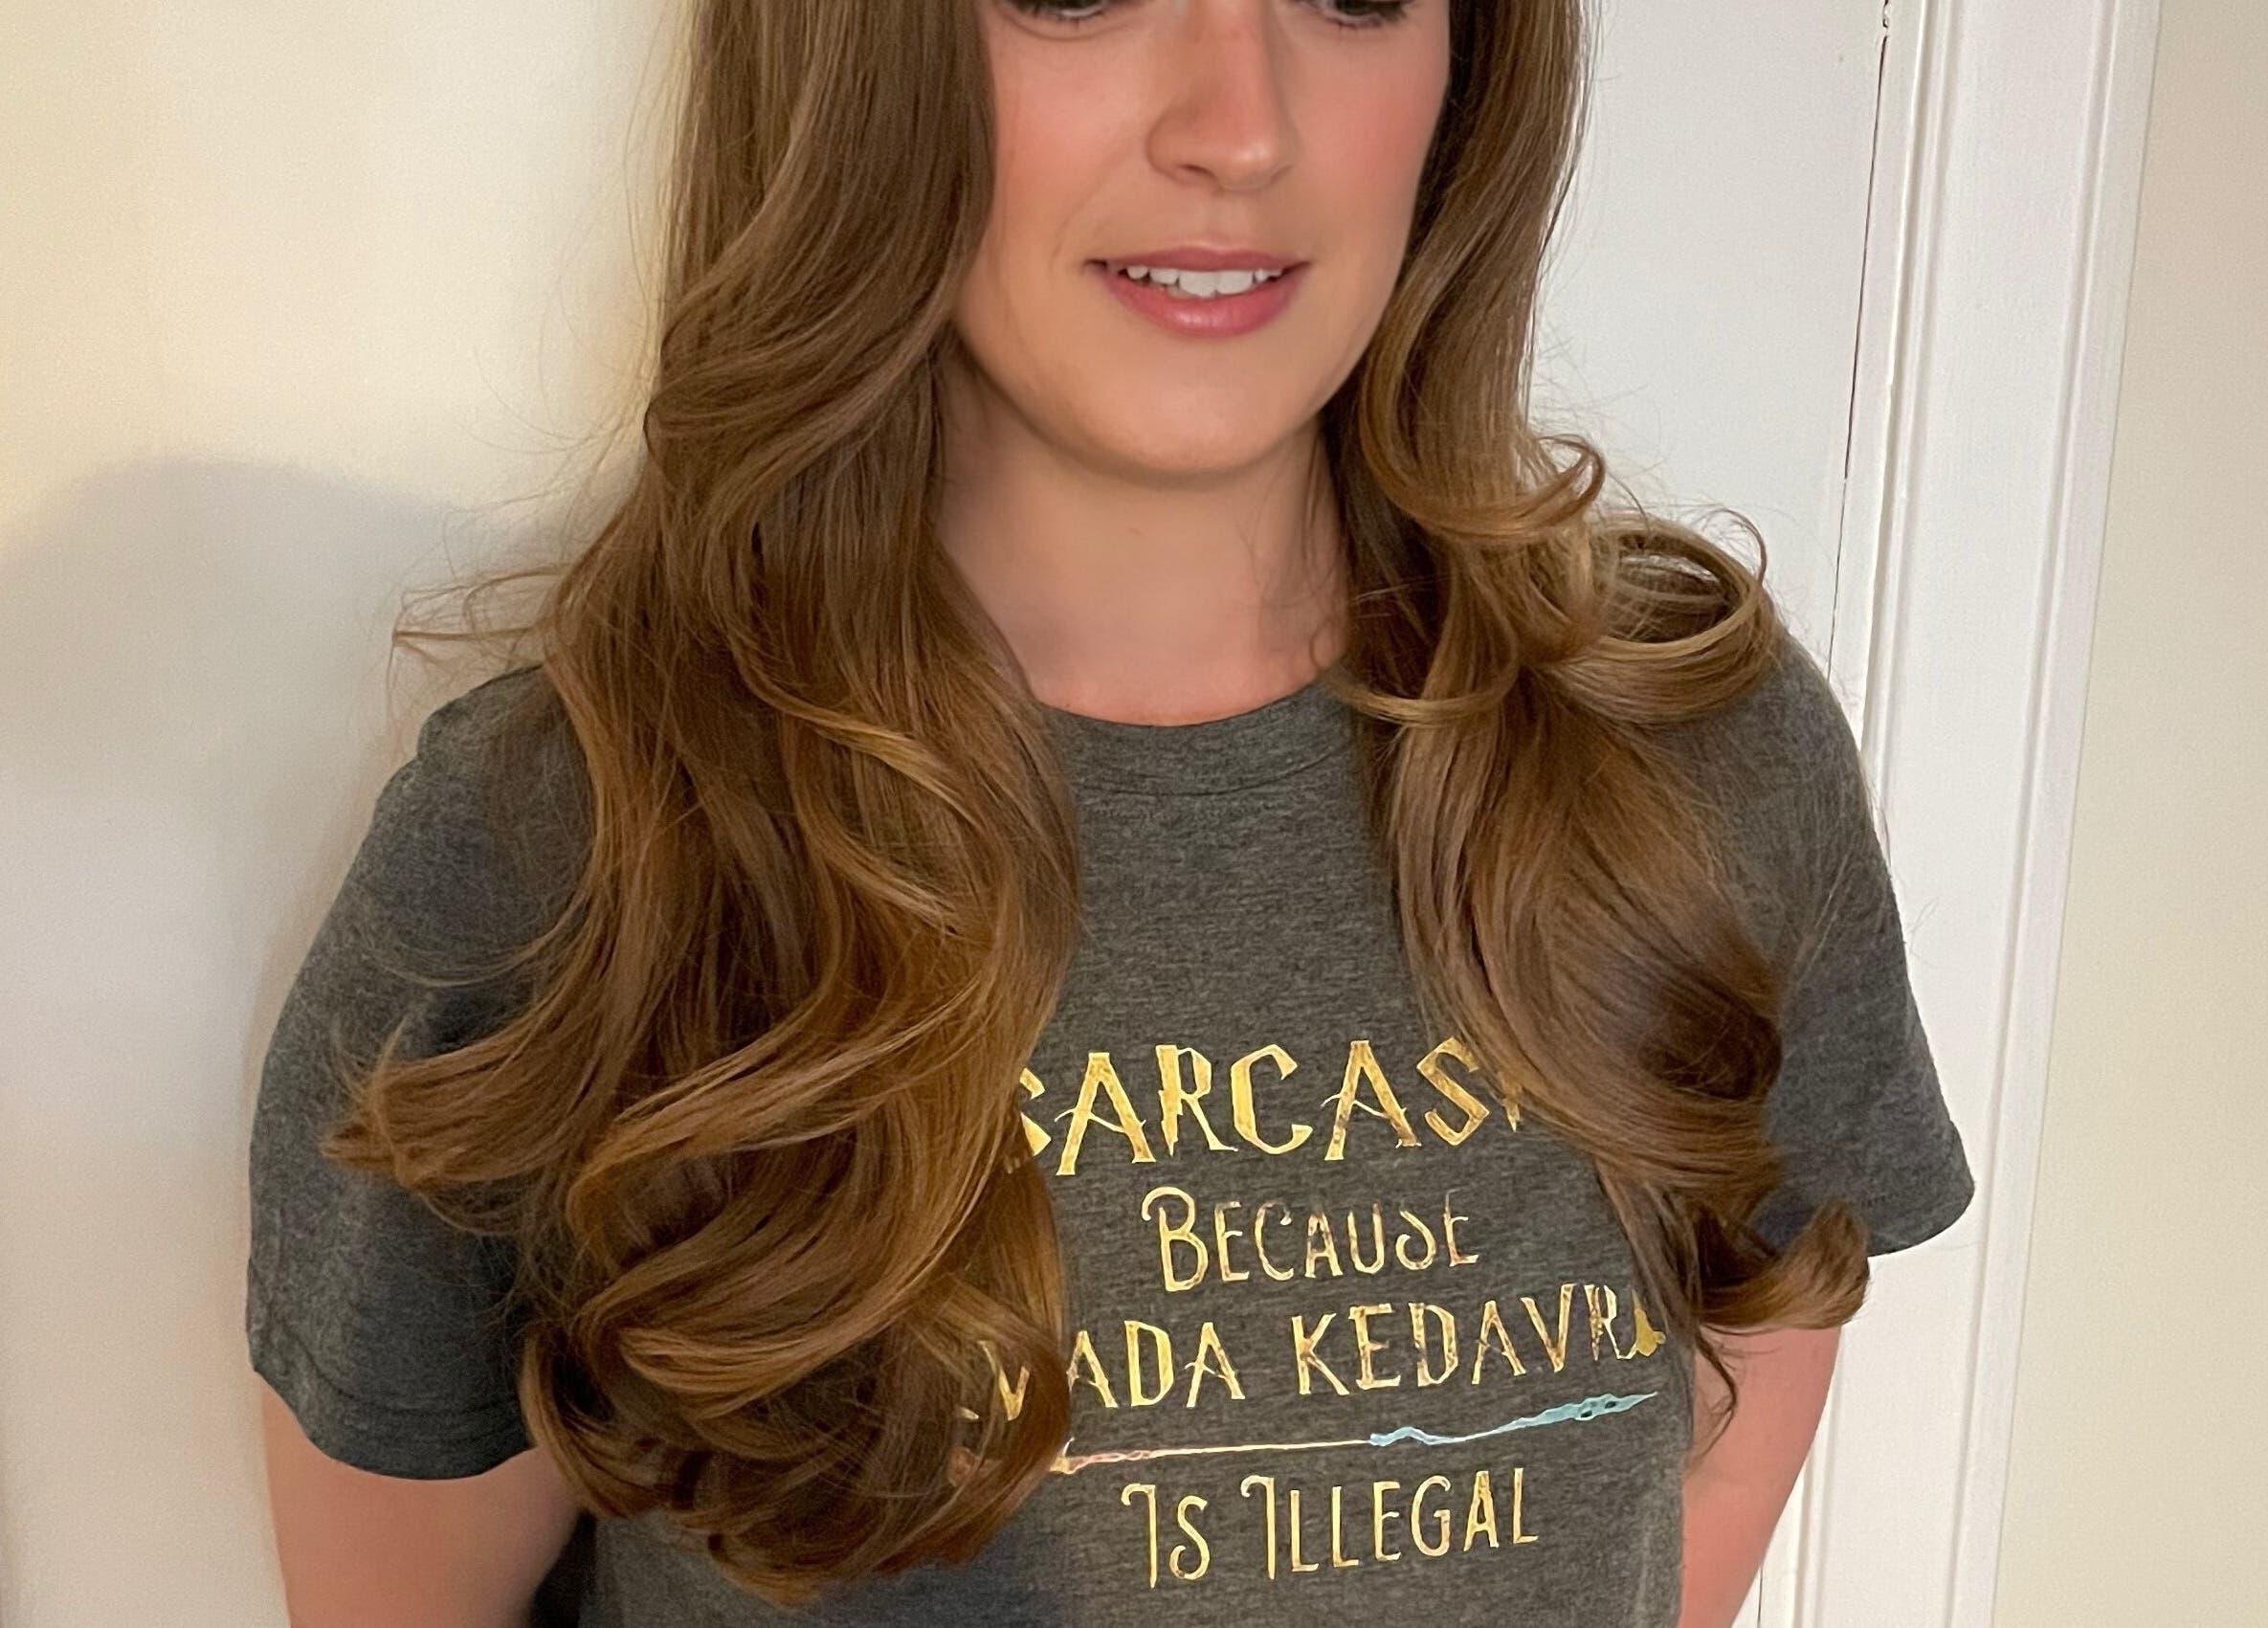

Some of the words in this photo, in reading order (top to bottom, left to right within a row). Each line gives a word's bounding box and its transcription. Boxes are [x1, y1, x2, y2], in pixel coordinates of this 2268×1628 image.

[957, 1320, 1245, 1420] VADA
[1120, 1483, 1211, 1589] IS
[1240, 1467, 1539, 1580] ILLEGAL
